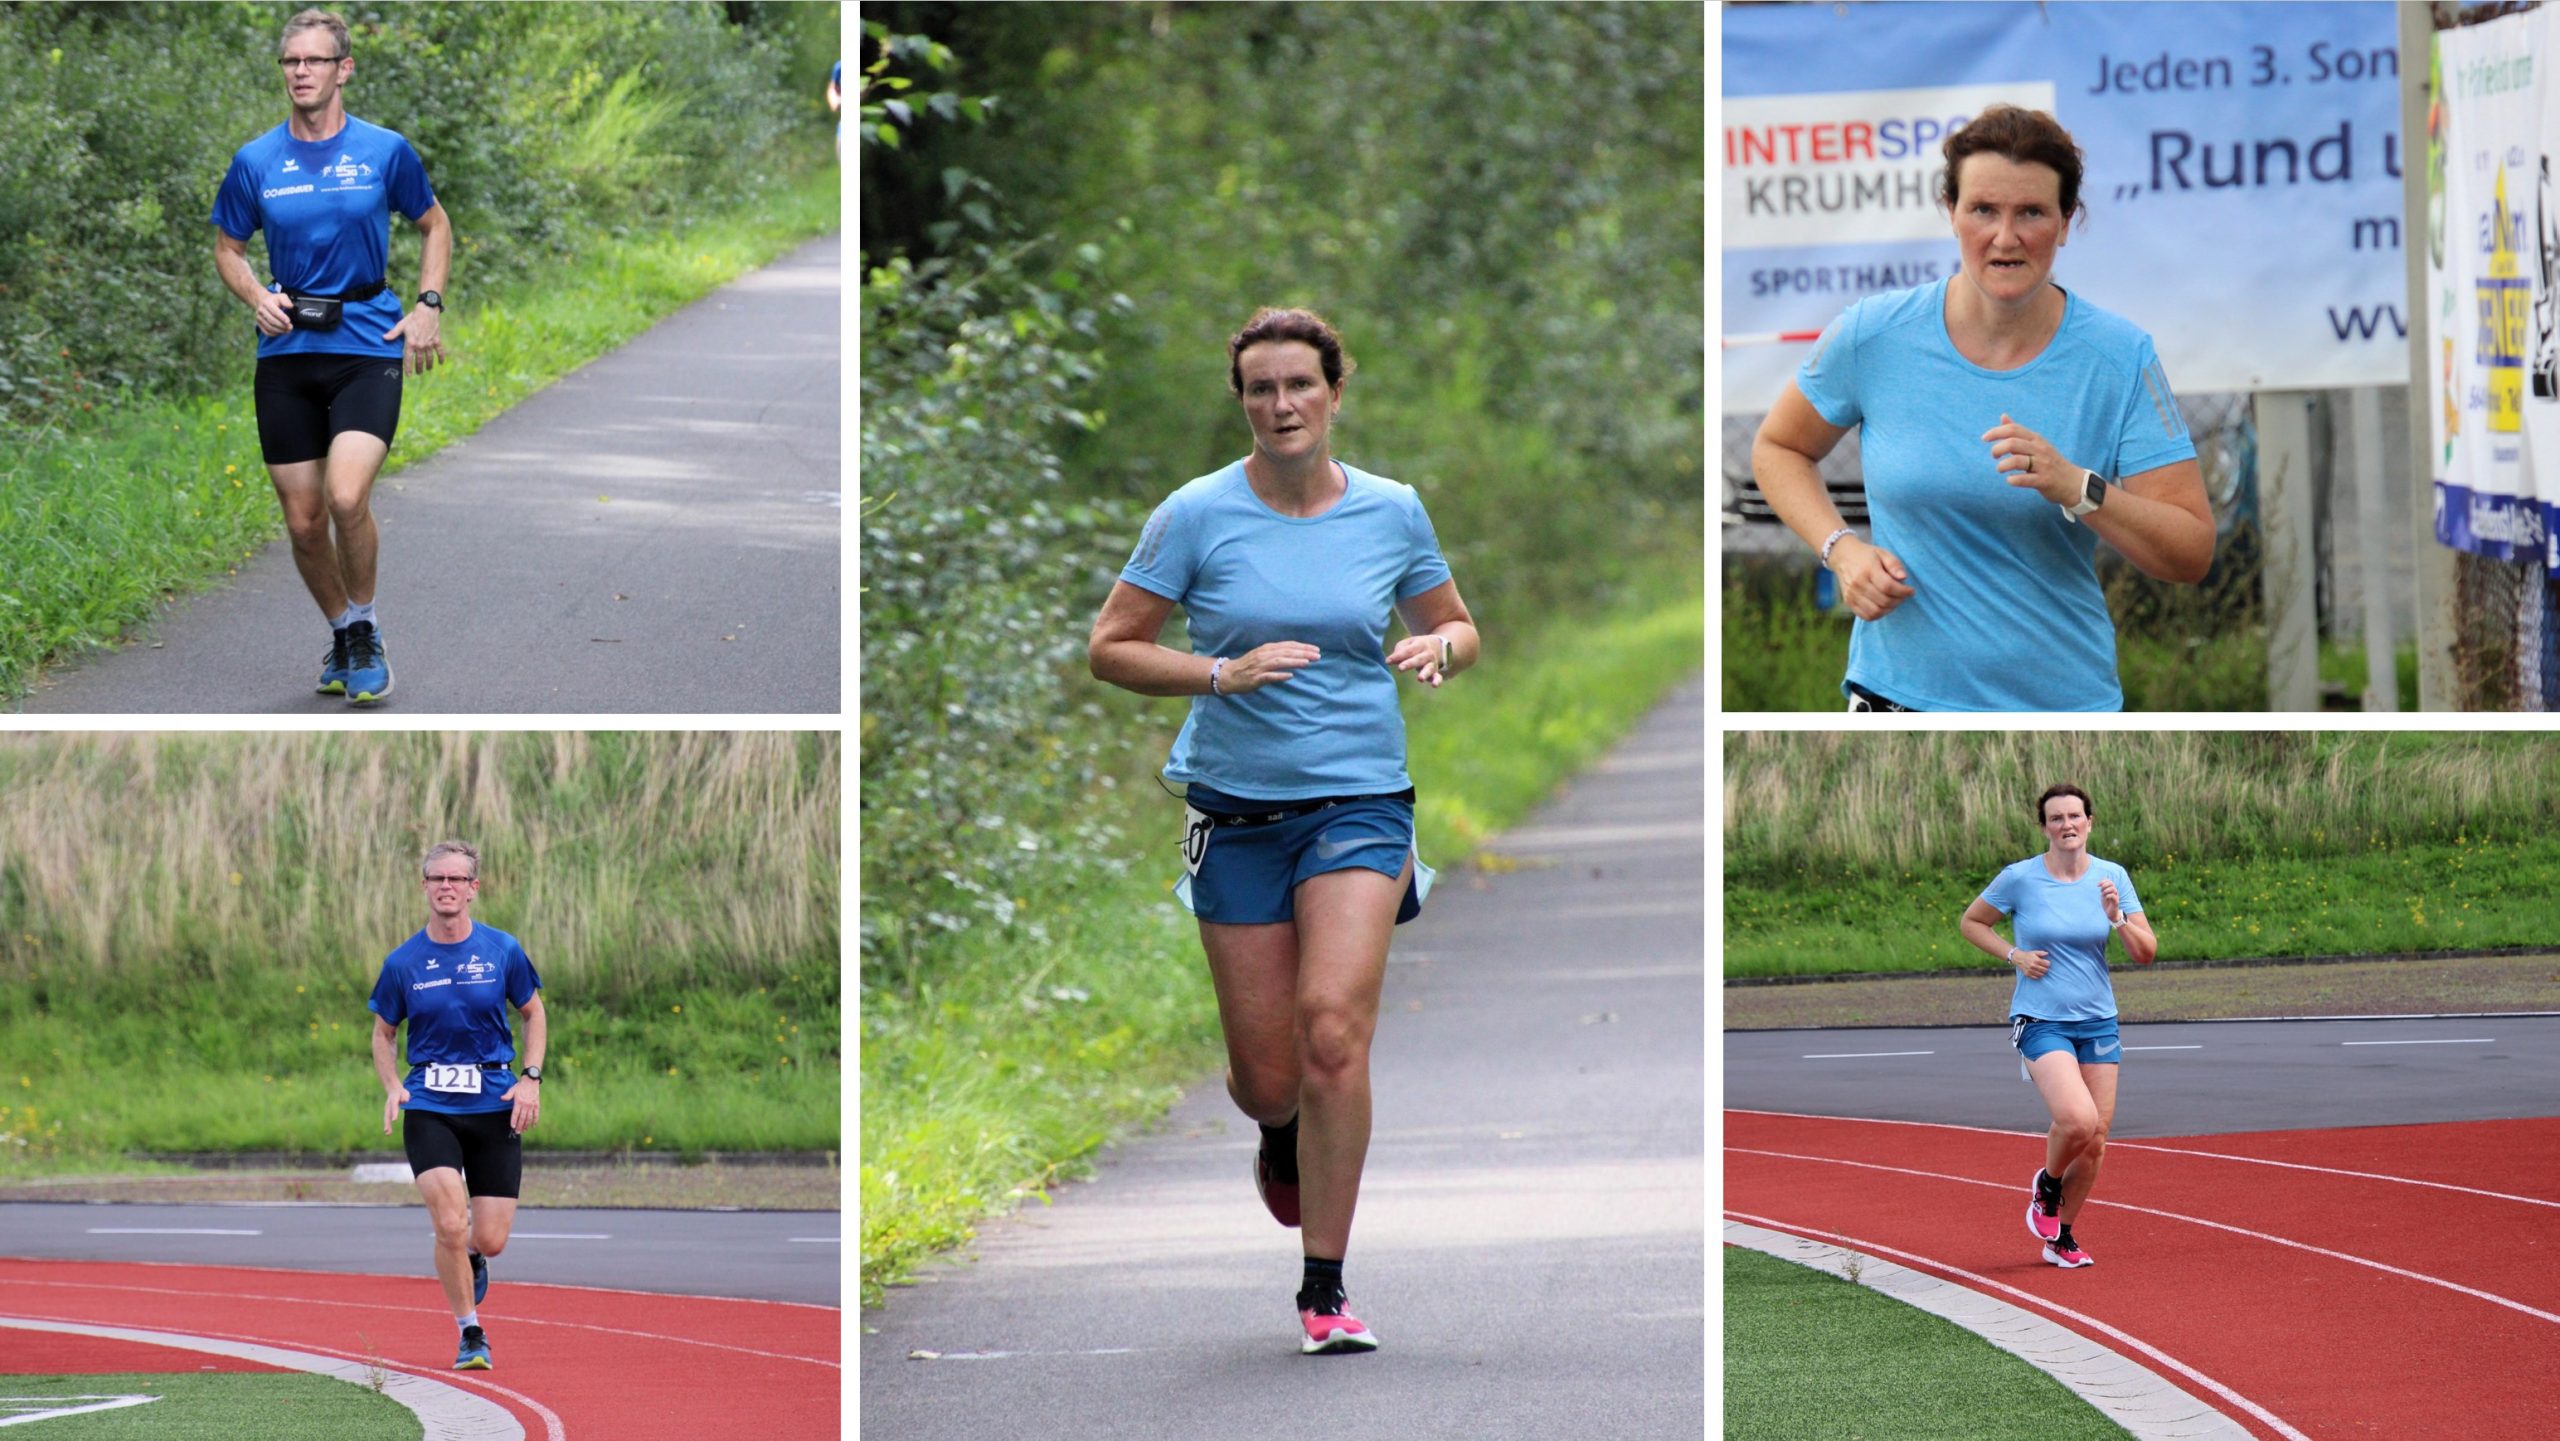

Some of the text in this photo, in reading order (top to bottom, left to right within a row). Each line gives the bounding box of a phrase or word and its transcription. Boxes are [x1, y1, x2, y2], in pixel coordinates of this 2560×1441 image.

[2089, 52, 2232, 96] Jeden
[2250, 45, 2292, 87] 3.
[1752, 260, 1940, 297] SPORTHAUS
[429, 1066, 477, 1089] 121
